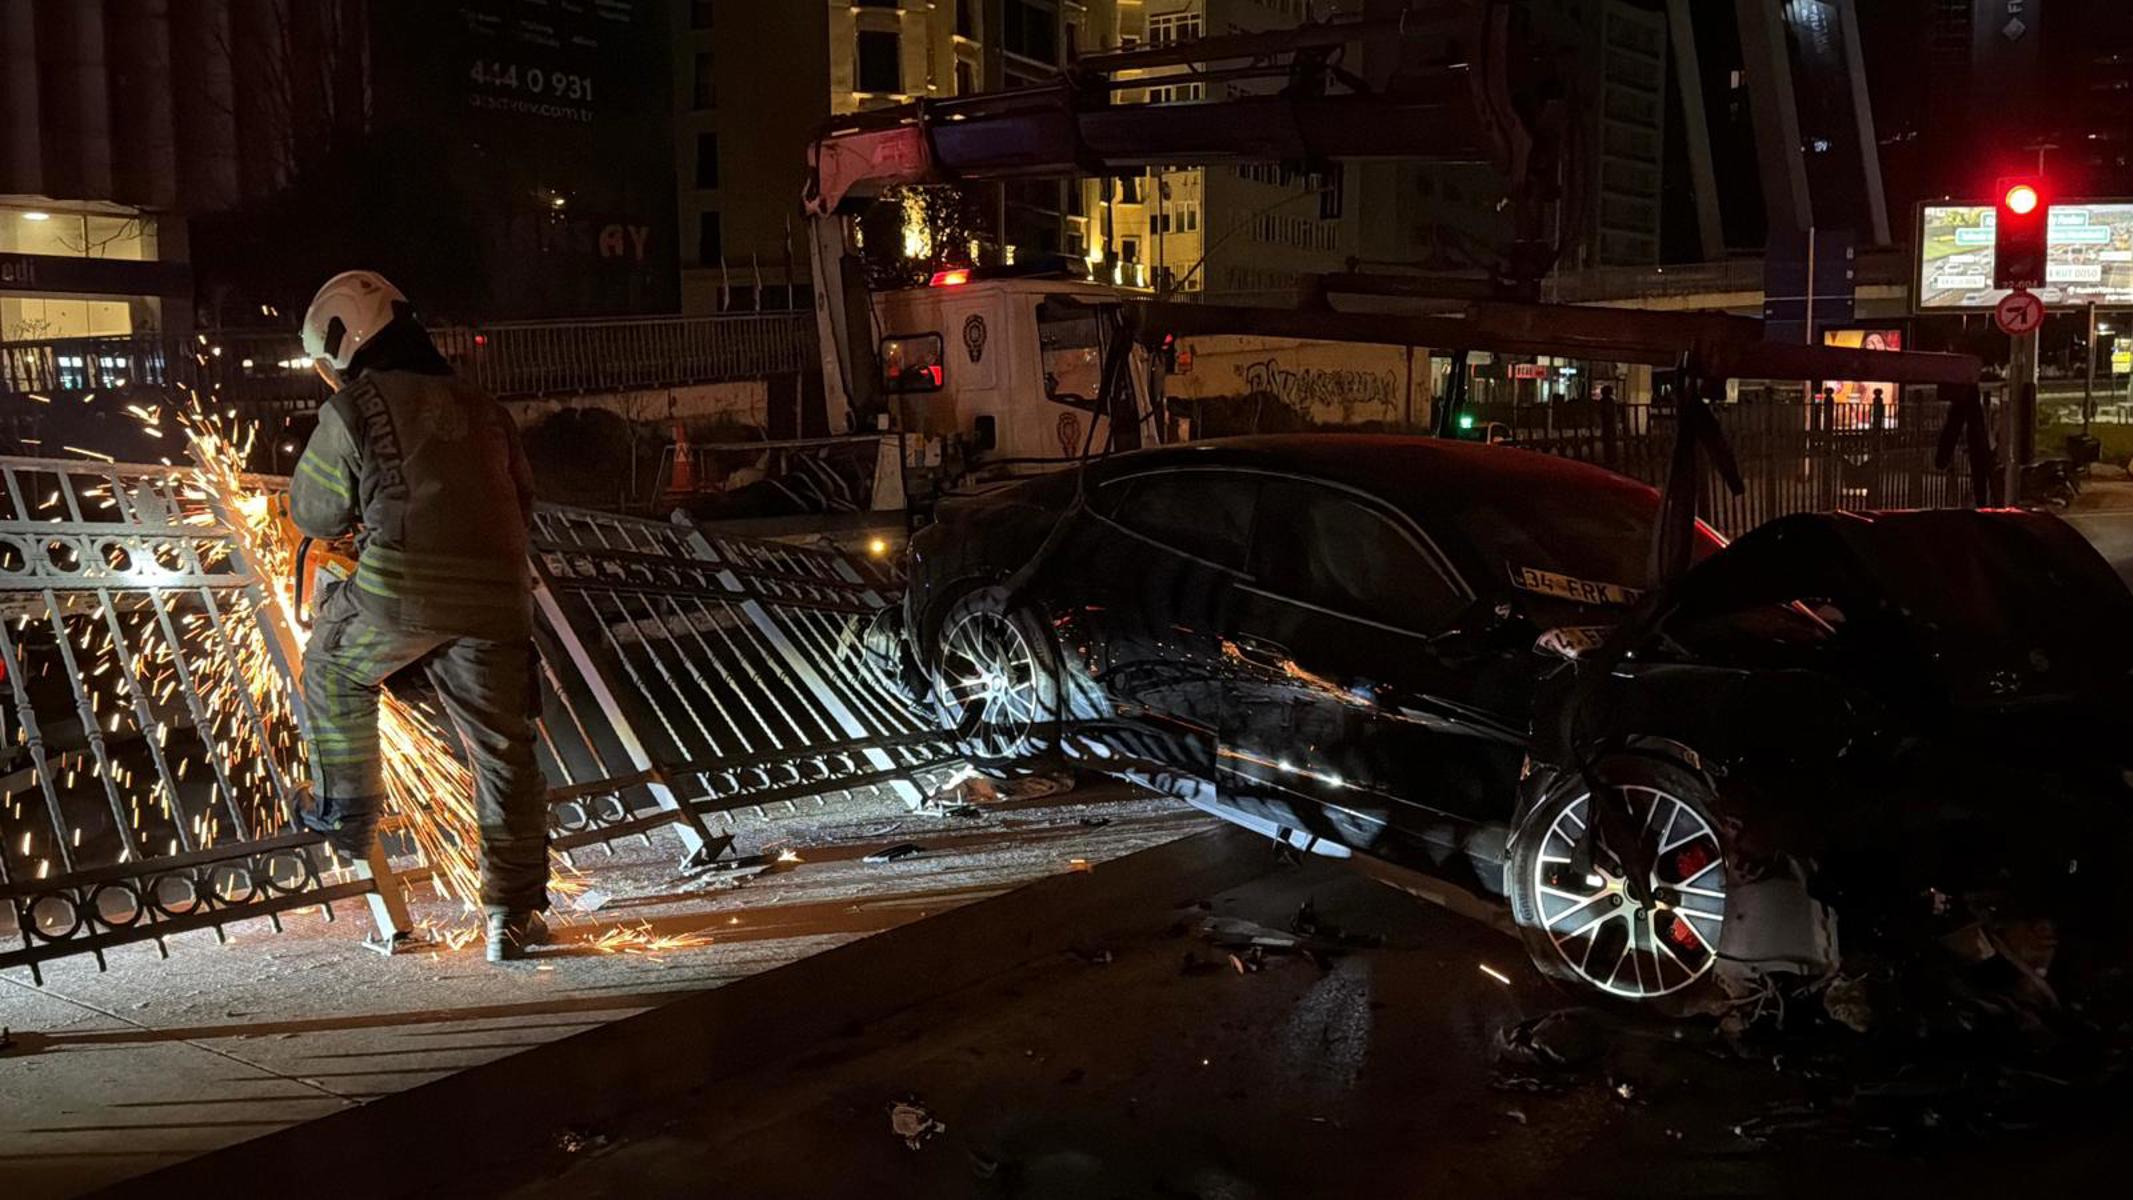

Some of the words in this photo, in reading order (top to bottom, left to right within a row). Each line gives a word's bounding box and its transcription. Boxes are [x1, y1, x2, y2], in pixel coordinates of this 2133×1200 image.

[527, 68, 544, 93] 0
[552, 71, 593, 101] 931
[1525, 570, 1554, 590] 34
[1567, 579, 1609, 602] FRK
